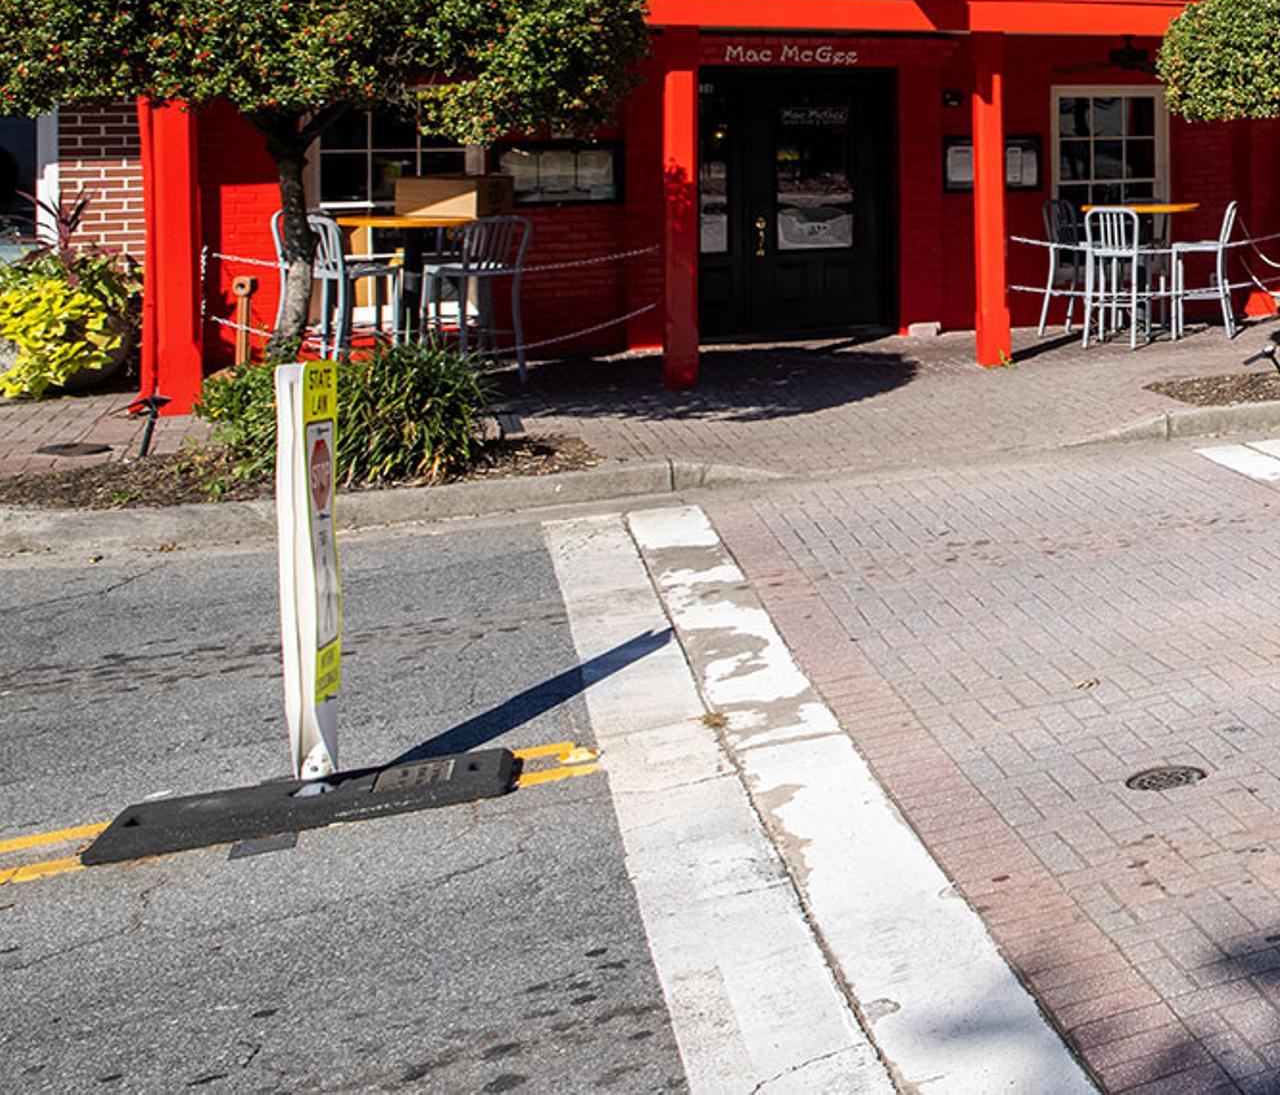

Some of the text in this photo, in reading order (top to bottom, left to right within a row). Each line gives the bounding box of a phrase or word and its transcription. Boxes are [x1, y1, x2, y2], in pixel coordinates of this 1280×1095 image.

[724, 44, 858, 64] Mac McGee
[309, 369, 331, 390] STATE
[312, 395, 328, 415] LAW
